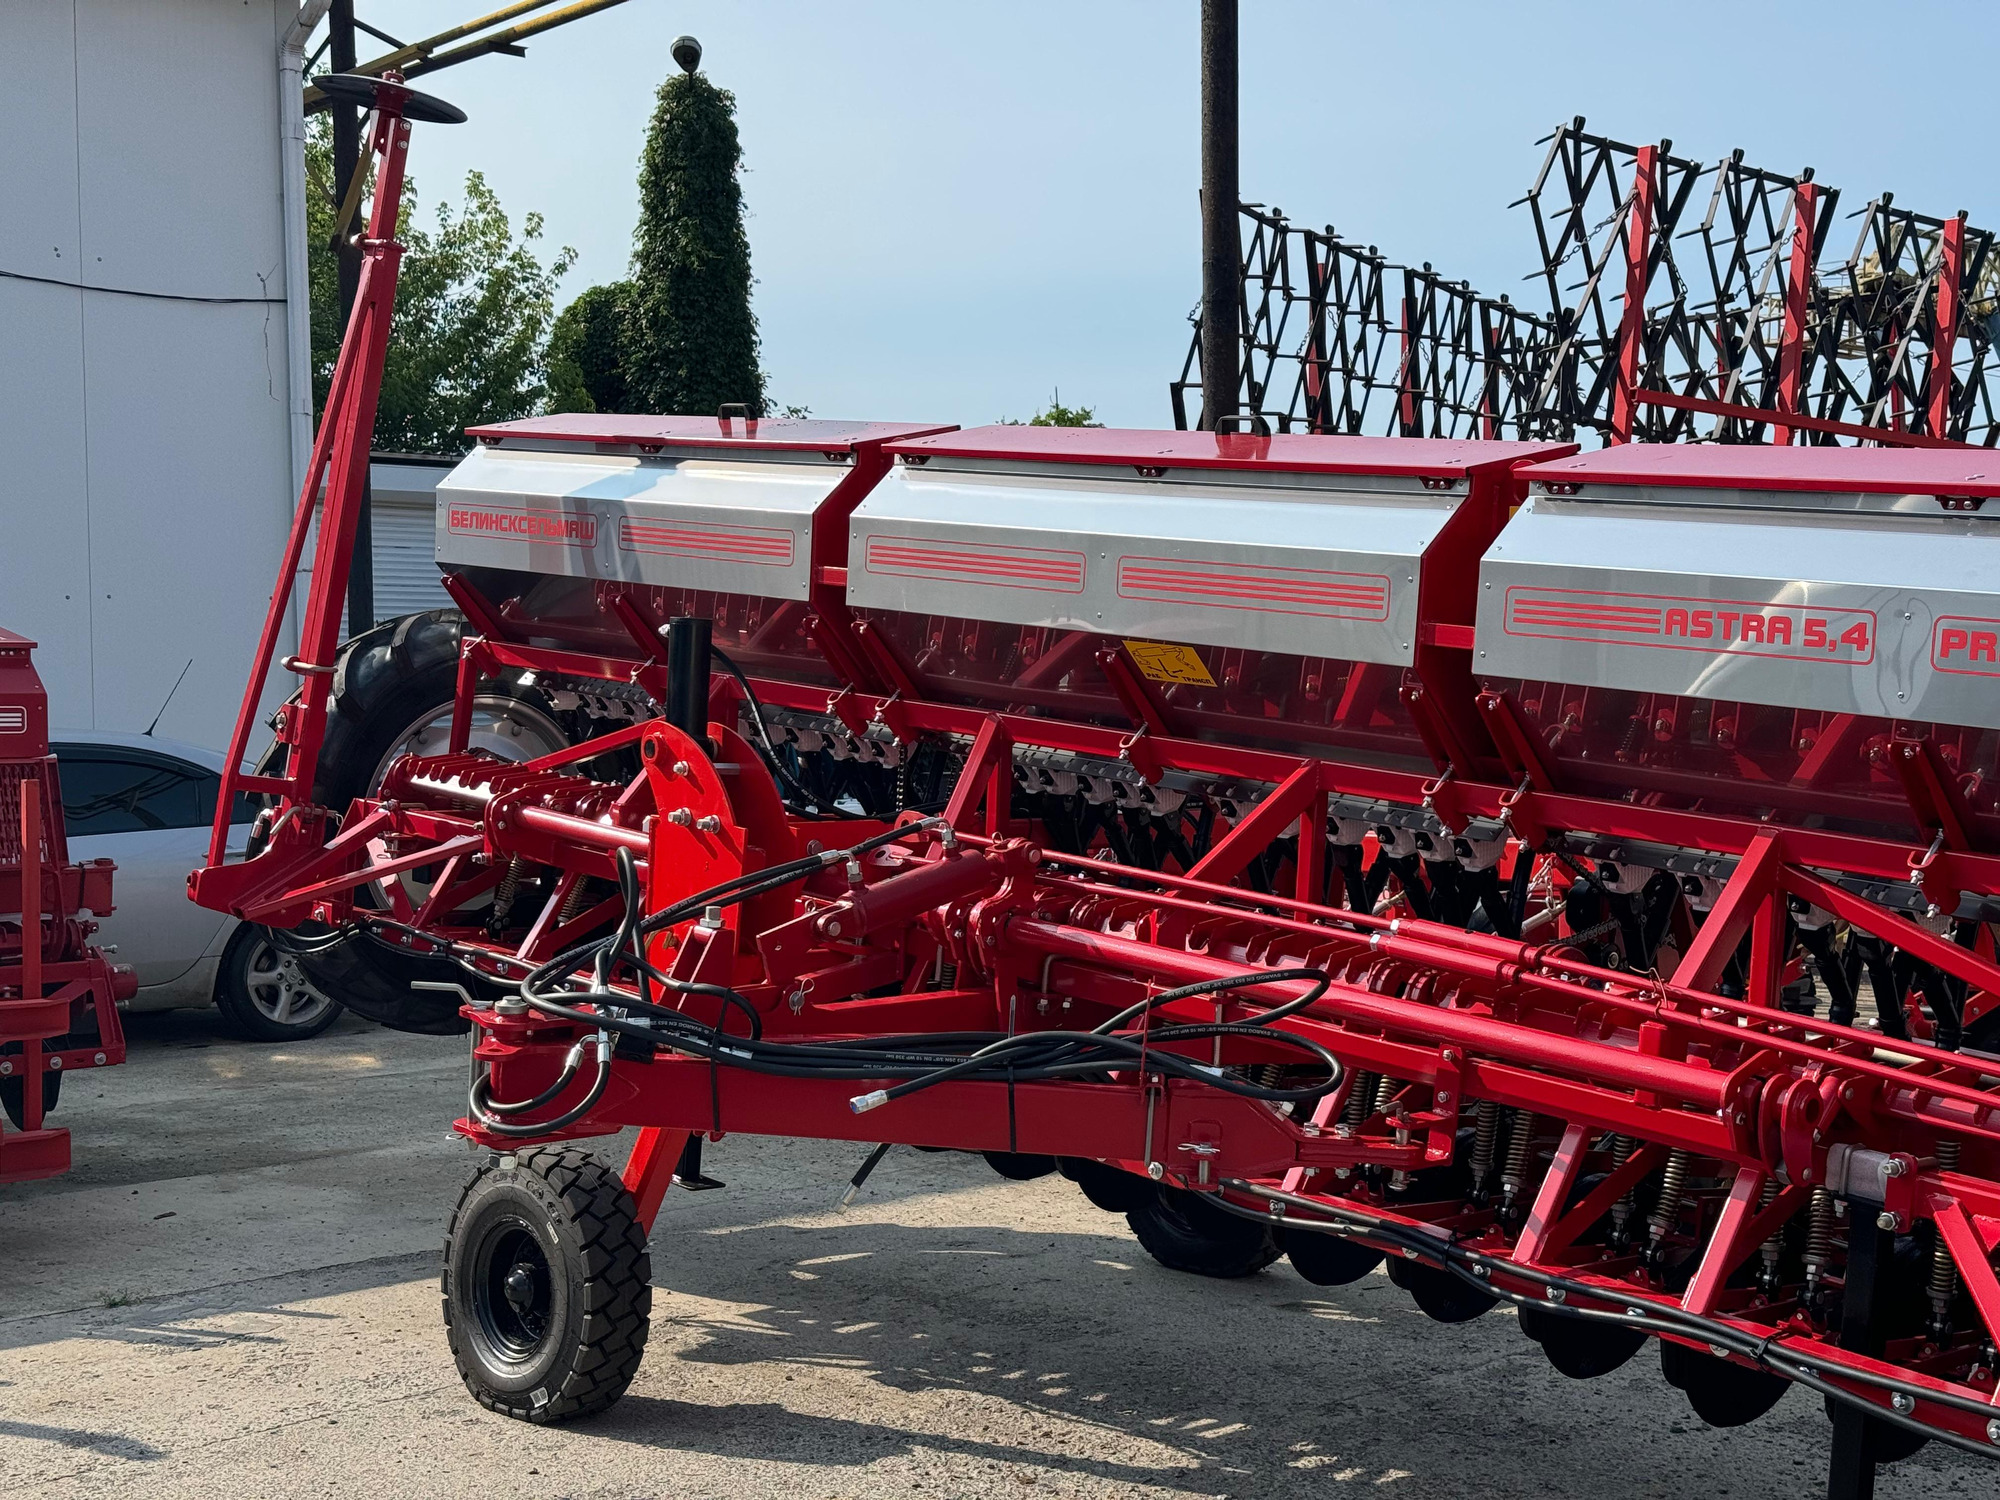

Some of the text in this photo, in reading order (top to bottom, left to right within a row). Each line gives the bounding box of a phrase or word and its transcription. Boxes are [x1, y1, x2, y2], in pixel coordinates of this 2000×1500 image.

[451, 510, 594, 540] БЕЛИНСКСЕЛЬМАШ
[1664, 608, 1869, 652] ASTRA 5,4
[1940, 628, 2000, 663] PR
[1256, 972, 1281, 981] SVAROG
[1248, 1028, 1271, 1036] SVAROG
